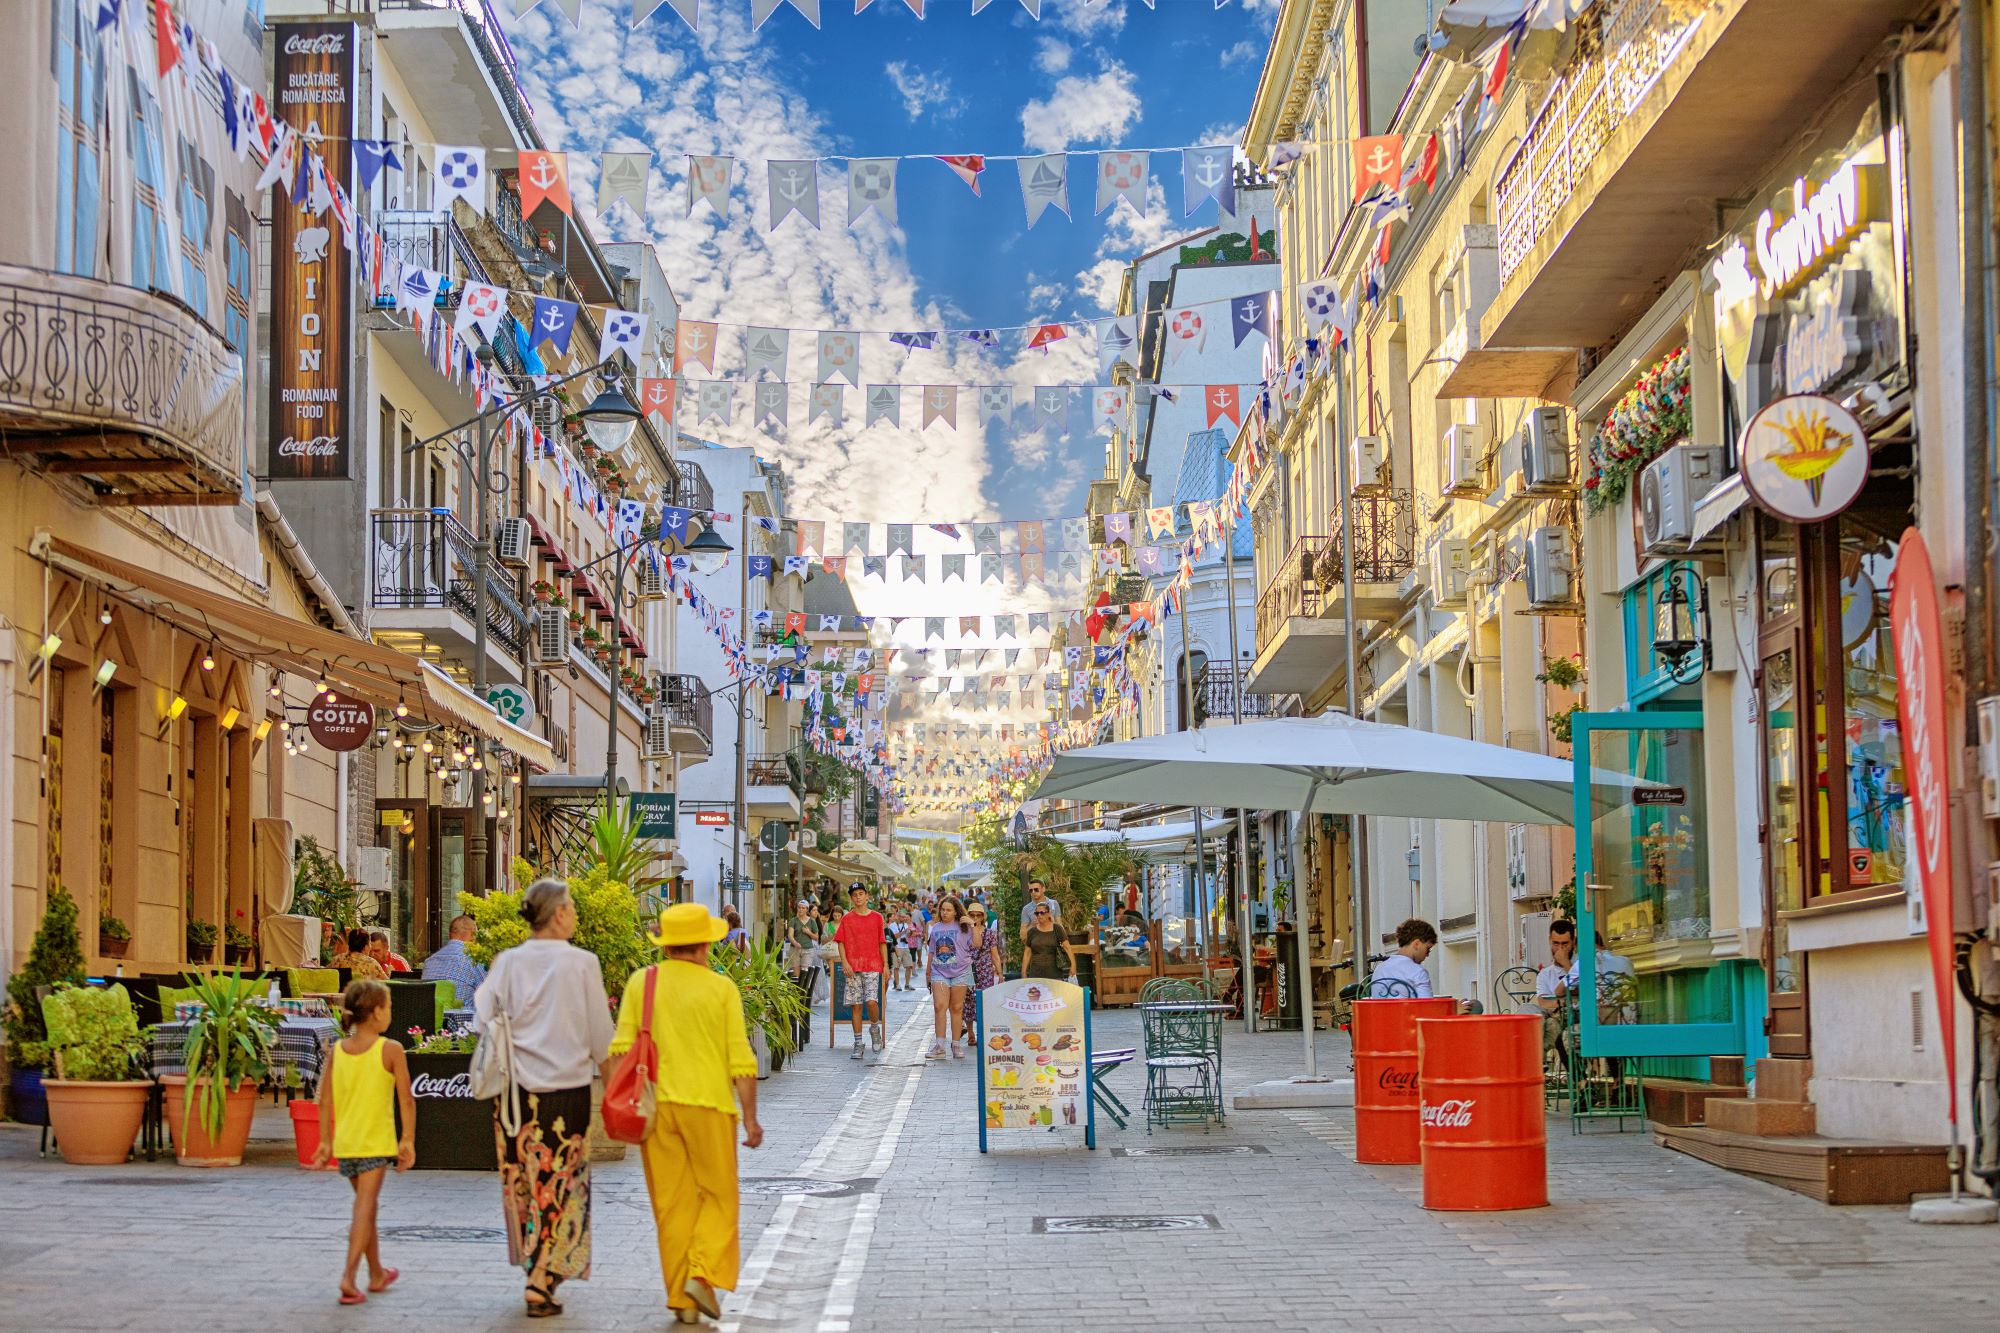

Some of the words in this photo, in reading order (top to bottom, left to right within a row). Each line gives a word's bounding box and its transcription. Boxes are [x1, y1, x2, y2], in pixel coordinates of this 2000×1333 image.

[284, 34, 345, 54] Coca-Cola
[282, 88, 345, 103] ROMÂNEASCĂ
[282, 388, 337, 402] ROMANIAN
[296, 405, 323, 419] FOOD
[278, 436, 339, 456] Coca-Cola
[312, 709, 369, 725] COSTA
[636, 803, 670, 812] DORIAN
[1008, 1001, 1061, 1011] GELATERIA
[988, 1055, 1025, 1065] LEMONADE
[410, 1072, 475, 1098] Coca-Col
[1014, 1103, 1031, 1111] Juice
